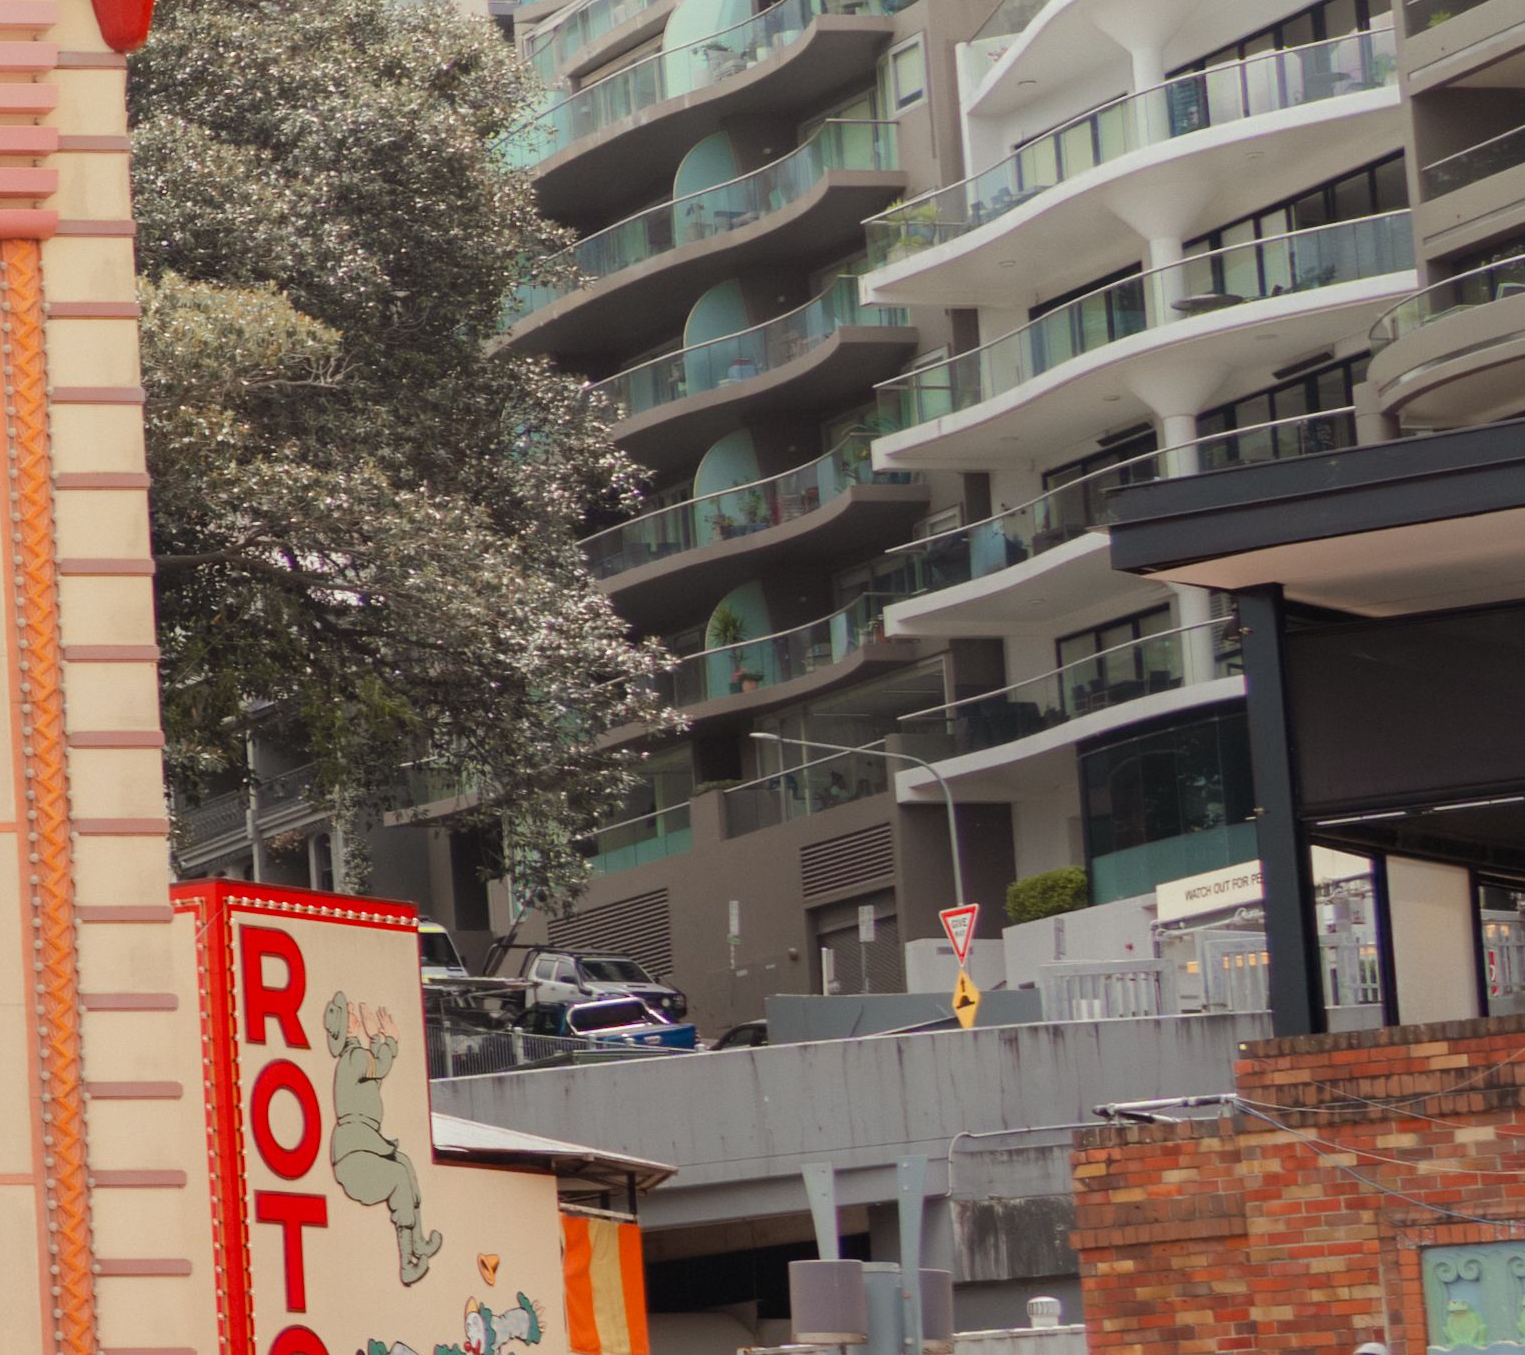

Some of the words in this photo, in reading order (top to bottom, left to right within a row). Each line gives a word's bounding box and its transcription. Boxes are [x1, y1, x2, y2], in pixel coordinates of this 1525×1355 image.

[1185, 885, 1211, 901] WATCH
[1213, 880, 1230, 894] OUT
[1232, 875, 1249, 889] FOR
[951, 917, 968, 929] GIVE
